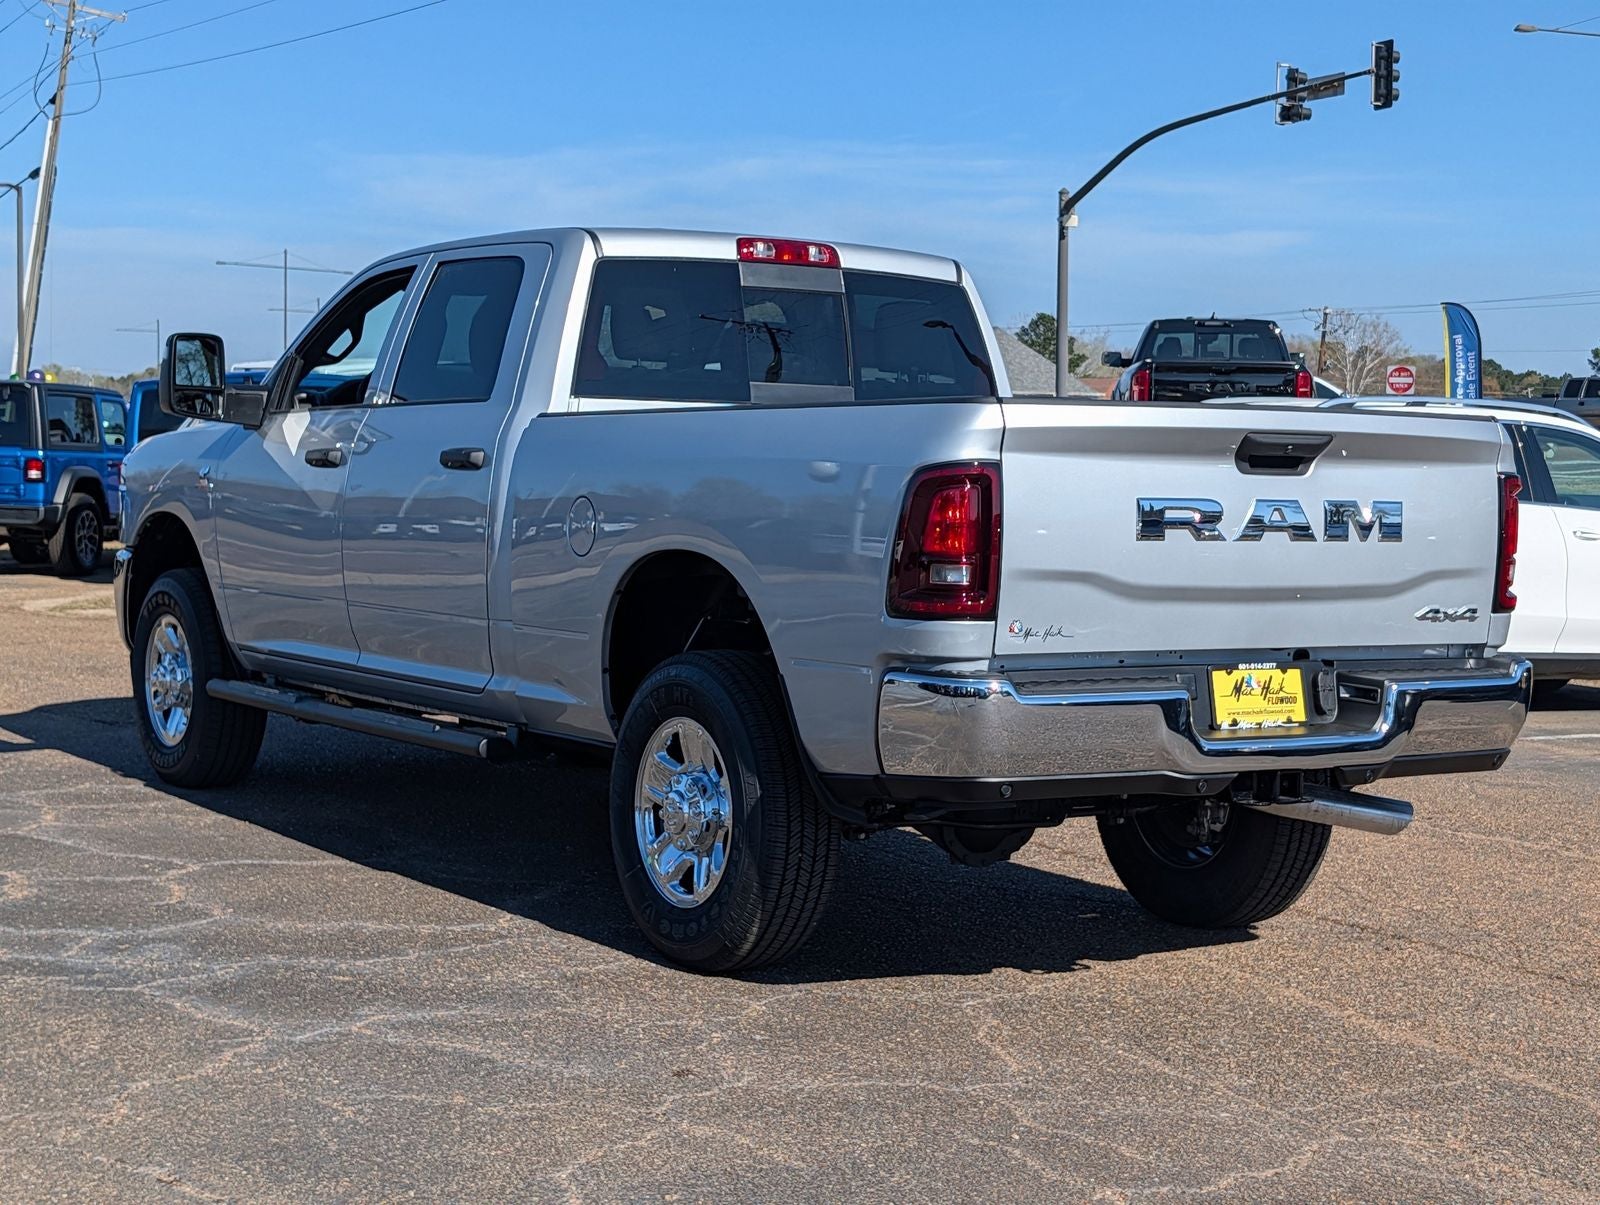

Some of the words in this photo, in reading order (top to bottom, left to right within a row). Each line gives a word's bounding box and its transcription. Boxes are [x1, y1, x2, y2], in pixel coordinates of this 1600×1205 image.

[1466, 351, 1476, 381] Event
[1136, 497, 1403, 542] RAM
[1016, 627, 1041, 643] Mac
[1226, 675, 1260, 702] Mac
[1260, 675, 1298, 701] Haik
[1267, 696, 1298, 705] FLOWOOD
